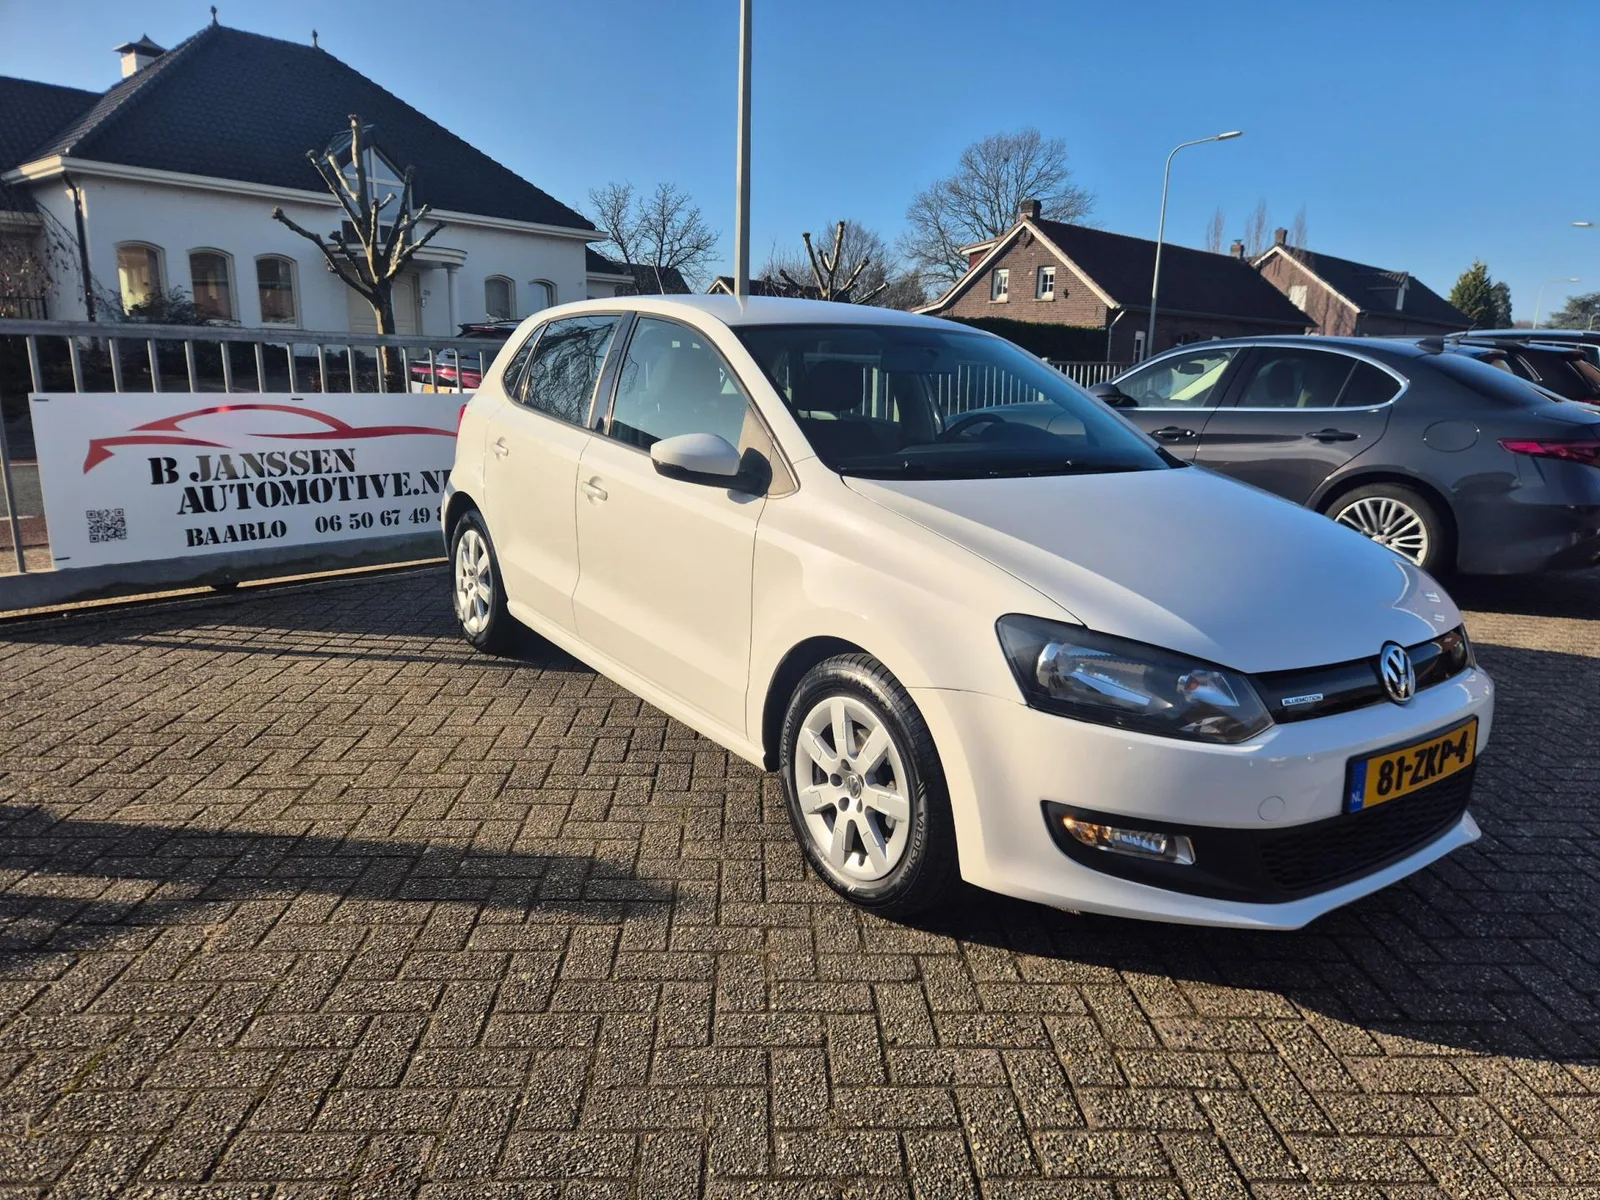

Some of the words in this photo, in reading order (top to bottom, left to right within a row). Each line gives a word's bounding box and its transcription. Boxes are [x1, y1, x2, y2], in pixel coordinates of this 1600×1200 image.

[147, 456, 180, 485] B
[188, 447, 356, 483] JANSSEN
[185, 519, 288, 547] BAARLO
[314, 514, 343, 534] 06
[349, 511, 374, 530] 50
[379, 508, 401, 527] 67
[408, 506, 431, 525] 49
[1376, 730, 1469, 796] 81-ZKP-4
[1351, 790, 1363, 804] NL
